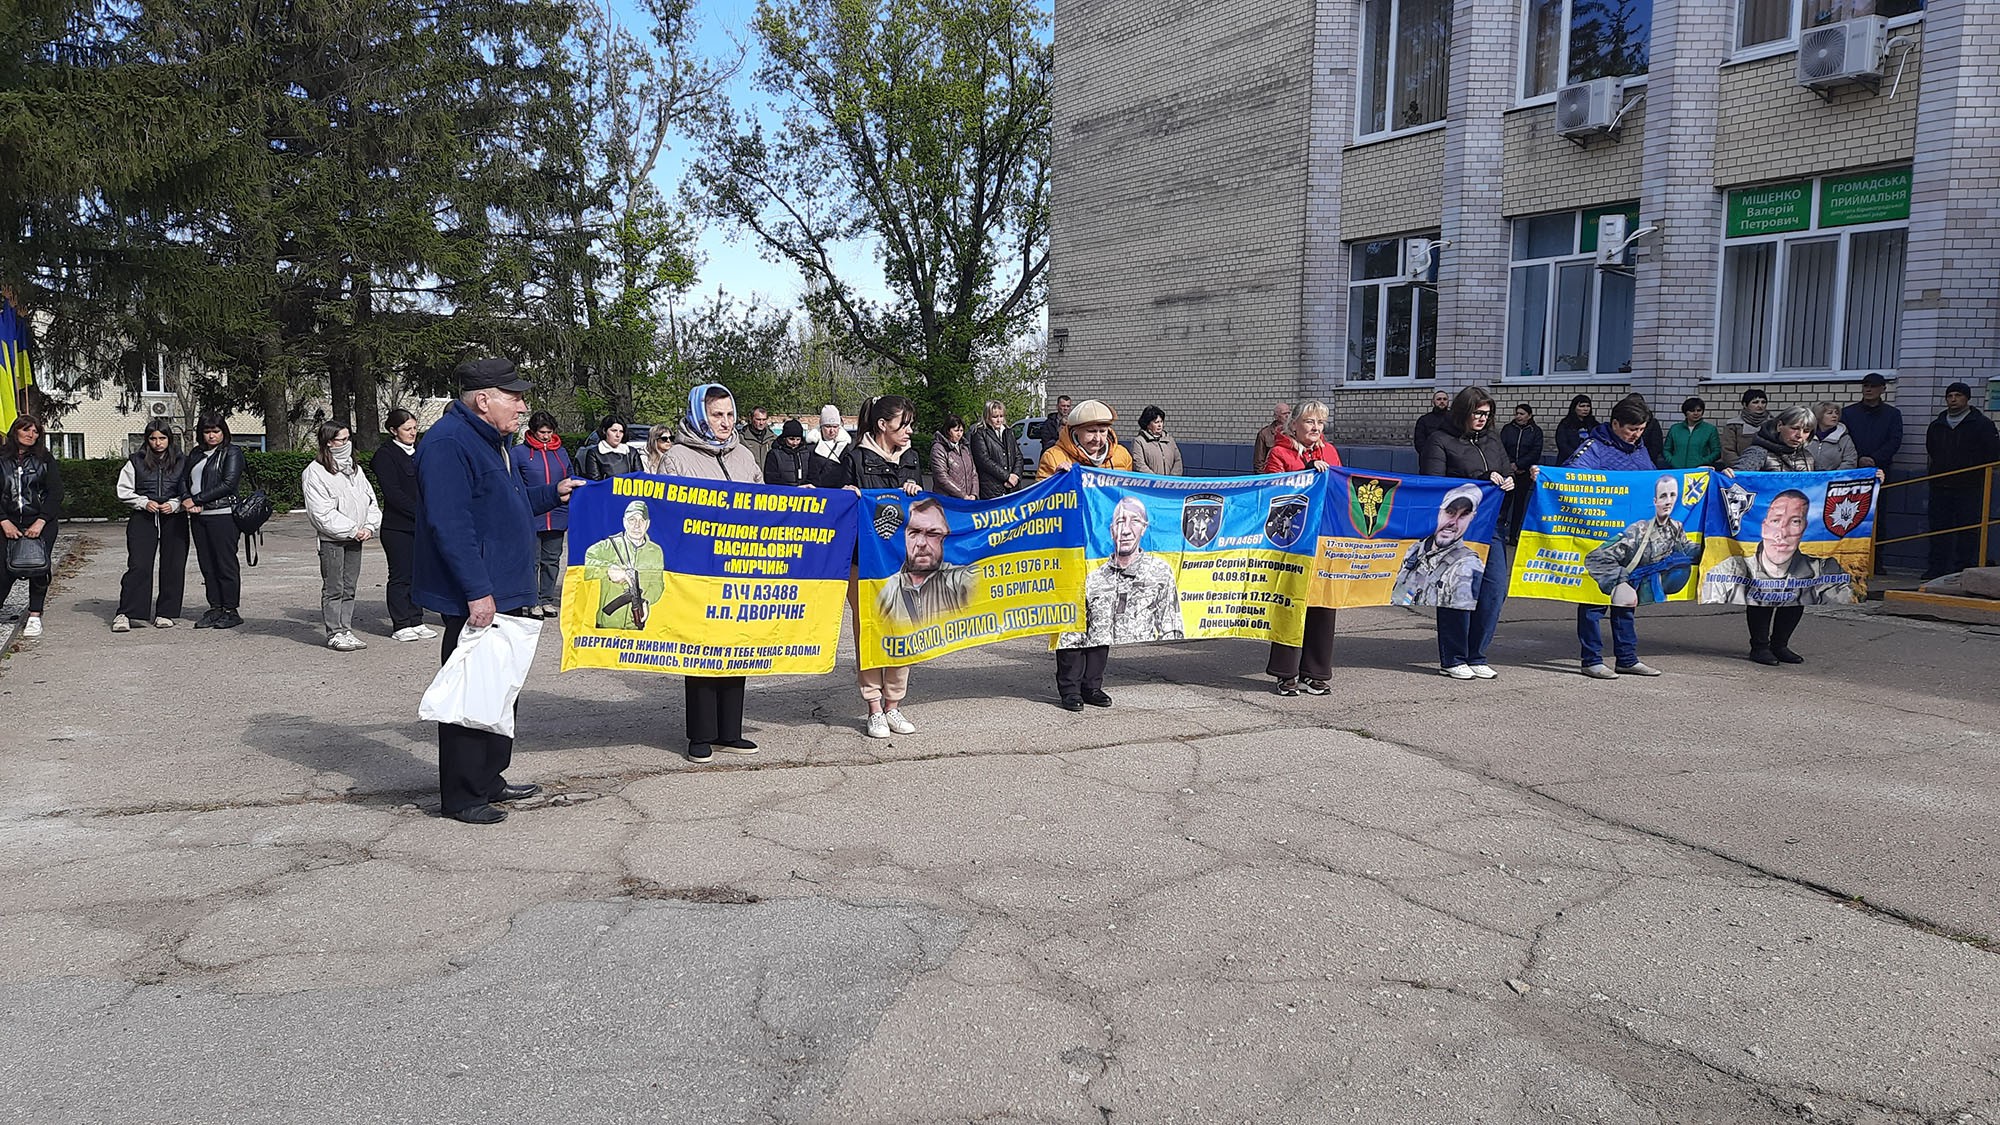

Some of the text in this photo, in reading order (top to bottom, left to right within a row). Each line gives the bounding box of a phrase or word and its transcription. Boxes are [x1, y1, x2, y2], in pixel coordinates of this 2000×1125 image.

[1832, 175, 1907, 194] ГРОМАДСЬКА
[1742, 189, 1801, 206] МІЩЕНКО
[1830, 190, 1907, 208] ПРИЙМАЛЬНЯ
[1747, 203, 1794, 217] Валерій
[1741, 217, 1799, 230] Петрович
[1096, 474, 1151, 488] ОКРЕМА
[1152, 479, 1254, 490] МЕХАНІЗОВАНА
[1577, 474, 1607, 482] ОКРЕМА
[612, 477, 827, 514] ПОЛОН ВБИВАЄ, НЕ МОВЧІТЬ!
[1596, 486, 1629, 495] БРИГАДА
[1558, 495, 1613, 505] ЗНИК БЕЗВІСТИ
[971, 507, 1020, 530] БУДАК
[683, 518, 836, 543] СИСТИЛЮК ОЛЕКСАНДР
[1552, 525, 1591, 535] ДОНЕЦЬКА
[713, 539, 802, 559] ВАСИЛЬОВИЧ
[1536, 548, 1580, 562] ДЕЙНЕГА
[724, 559, 788, 575] «МУРЧИК»
[1043, 558, 1062, 571] Р.Н.
[1182, 558, 1304, 575] Бригар Сергій Вікторович
[1526, 560, 1585, 575] ОЛЕКСАНДР
[1212, 571, 1268, 583] 04.09.81 р.н.
[1522, 573, 1582, 586] СЕРГІЙОВИЧ
[1750, 578, 1784, 589] Микола
[722, 583, 798, 600] В\Ч А3488
[990, 577, 1055, 599] 59 БРИГАДА
[1181, 592, 1205, 601] Зник
[1206, 591, 1248, 601] безвісти
[706, 603, 806, 622] н.п. ДВОРІЧНЕ
[1207, 604, 1266, 615] н.п. Торецьк
[882, 603, 1077, 658] ЧЕКАЄМО, ВІРИМО, ЛЮБИМО!
[1199, 617, 1272, 630] Донецької обл.
[636, 640, 678, 653] ЖИВИМ!
[679, 643, 701, 655] ВСЯ
[734, 647, 755, 657] ТЕБЕ
[757, 646, 783, 656] ЧЕКАЄ
[785, 645, 821, 657] ВДОМА!
[619, 652, 773, 670] МОЛИМОСЬ, ВІРИМО, ЛЮБИМО!
